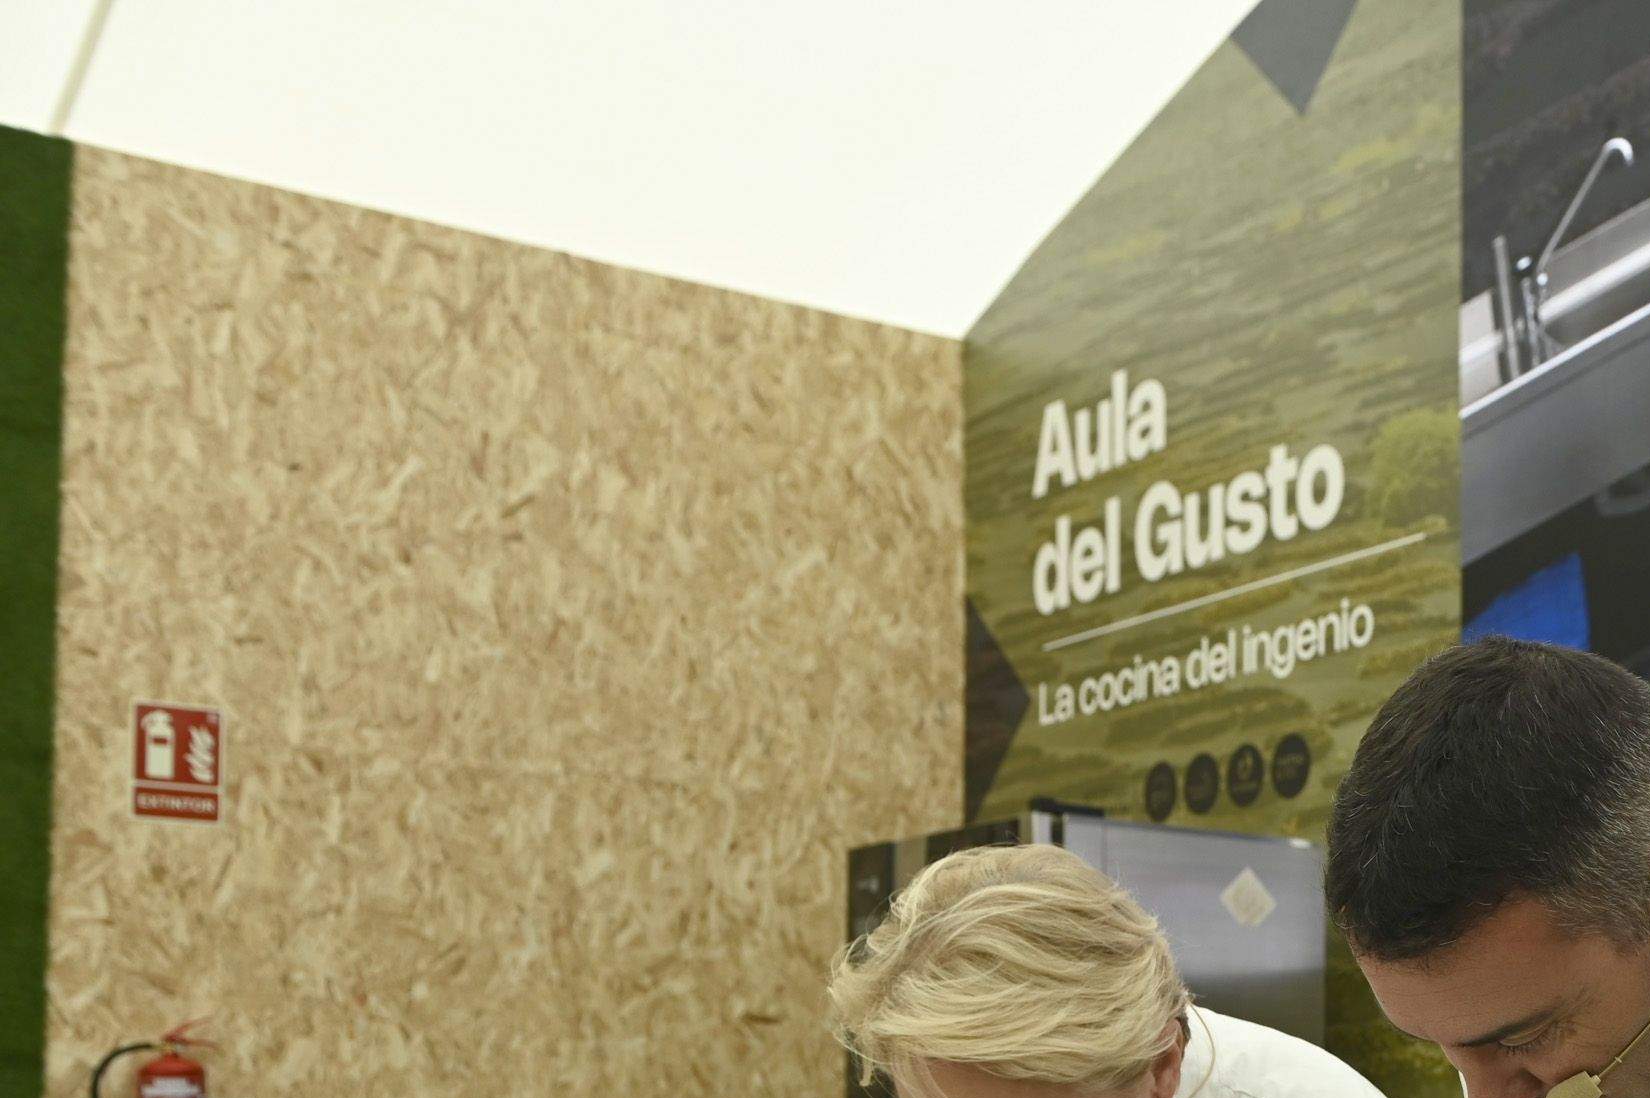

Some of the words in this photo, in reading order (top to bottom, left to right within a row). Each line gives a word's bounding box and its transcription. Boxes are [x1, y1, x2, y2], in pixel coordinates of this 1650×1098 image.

[1032, 369, 1167, 498] Aula
[1033, 497, 1121, 615] del
[1135, 443, 1345, 582] Gusto
[1038, 681, 1074, 727] La
[1079, 651, 1180, 716] cocina
[1185, 629, 1237, 689] del
[1242, 598, 1374, 679] ingenio
